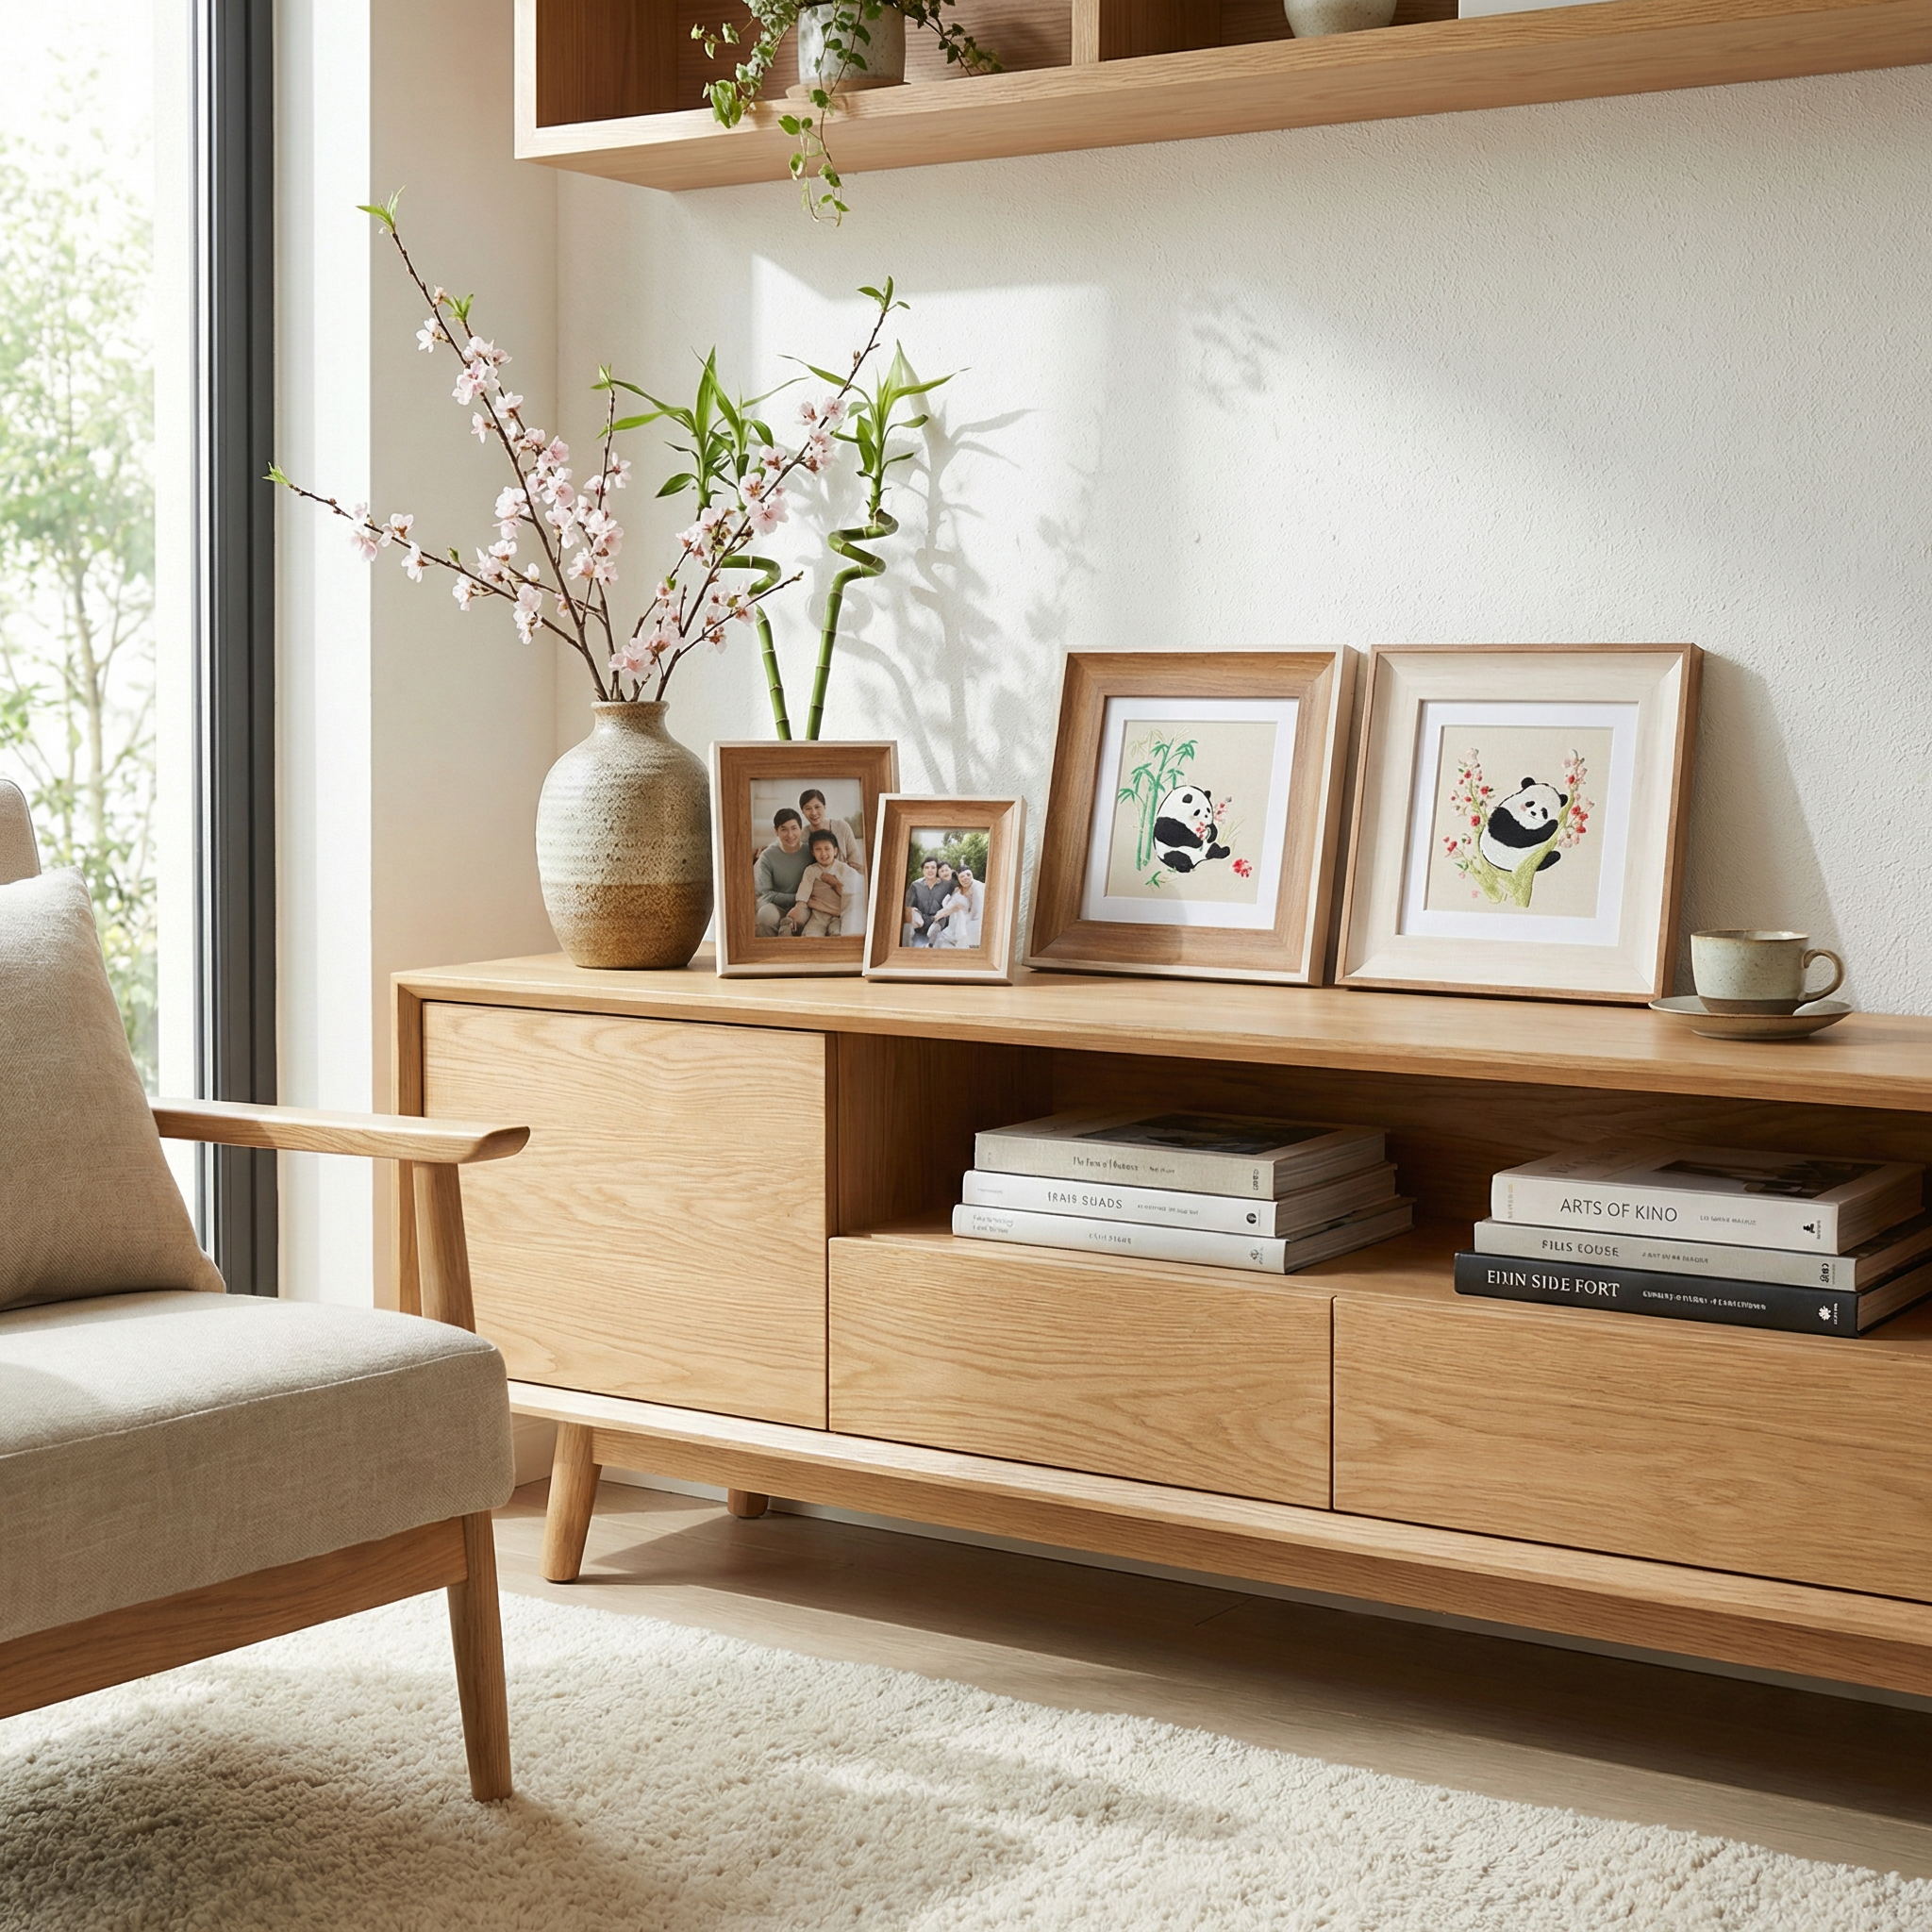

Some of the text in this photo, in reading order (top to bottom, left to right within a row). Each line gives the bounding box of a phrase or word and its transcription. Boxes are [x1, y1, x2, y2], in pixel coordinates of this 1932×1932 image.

[1559, 1198, 1677, 1223] ARTS OF KINO
[1531, 1274, 1571, 1291] SIDE
[1574, 1278, 1621, 1298] FORT
